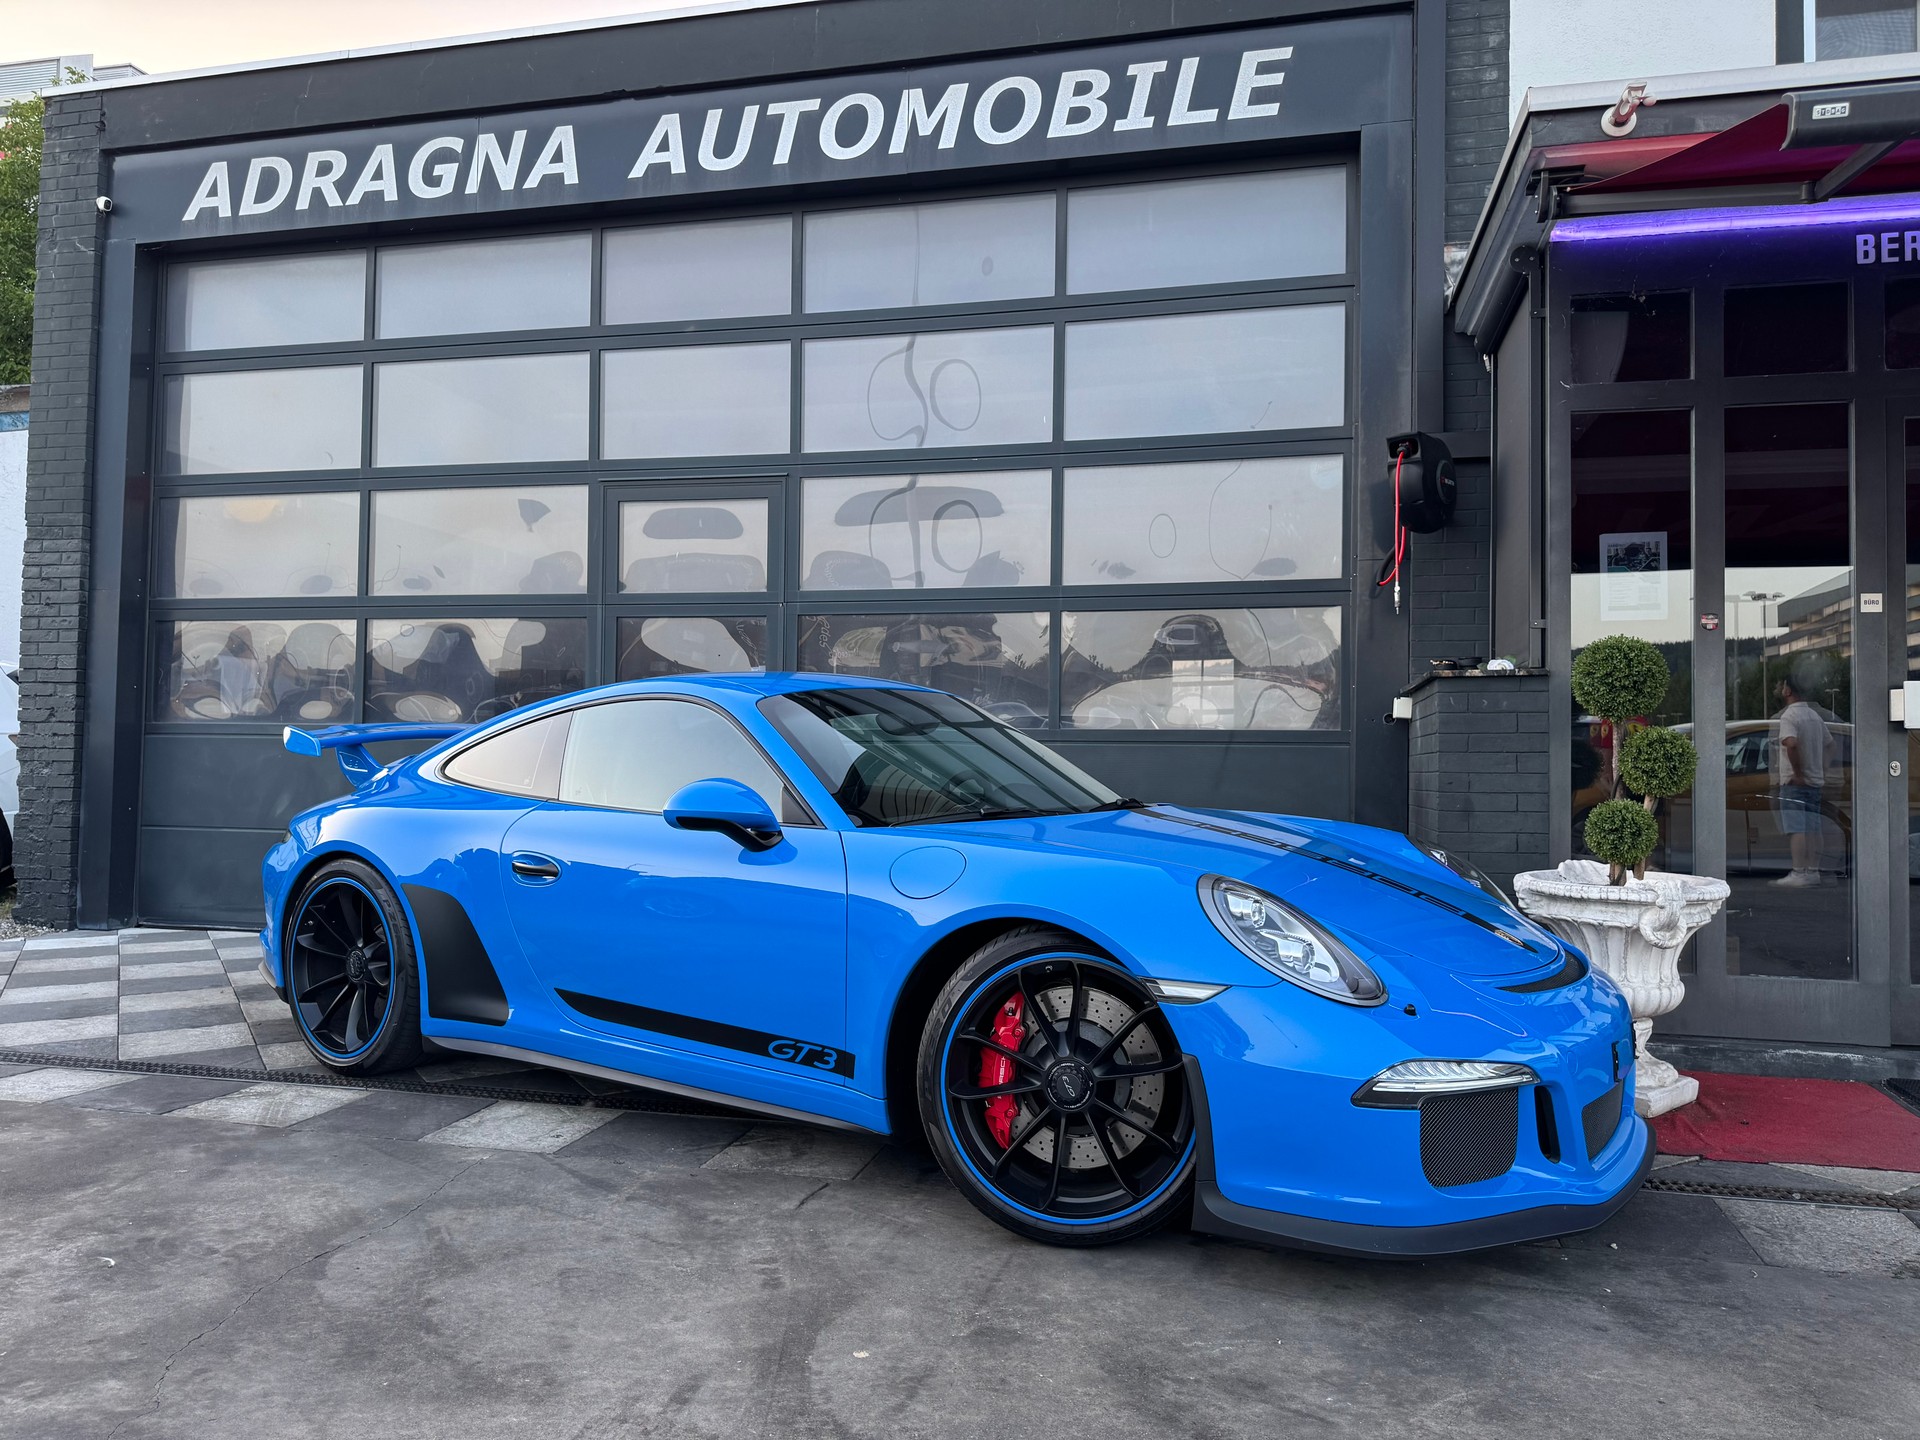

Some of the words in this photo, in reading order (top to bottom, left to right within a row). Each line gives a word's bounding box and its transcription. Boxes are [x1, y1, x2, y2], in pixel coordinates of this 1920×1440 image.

[181, 125, 579, 222] ADRAGNA
[627, 46, 1294, 179] AUTOMOBILE
[1855, 230, 1920, 265] BER
[1863, 598, 1880, 606] BÜRO
[768, 1039, 838, 1070] GT3
